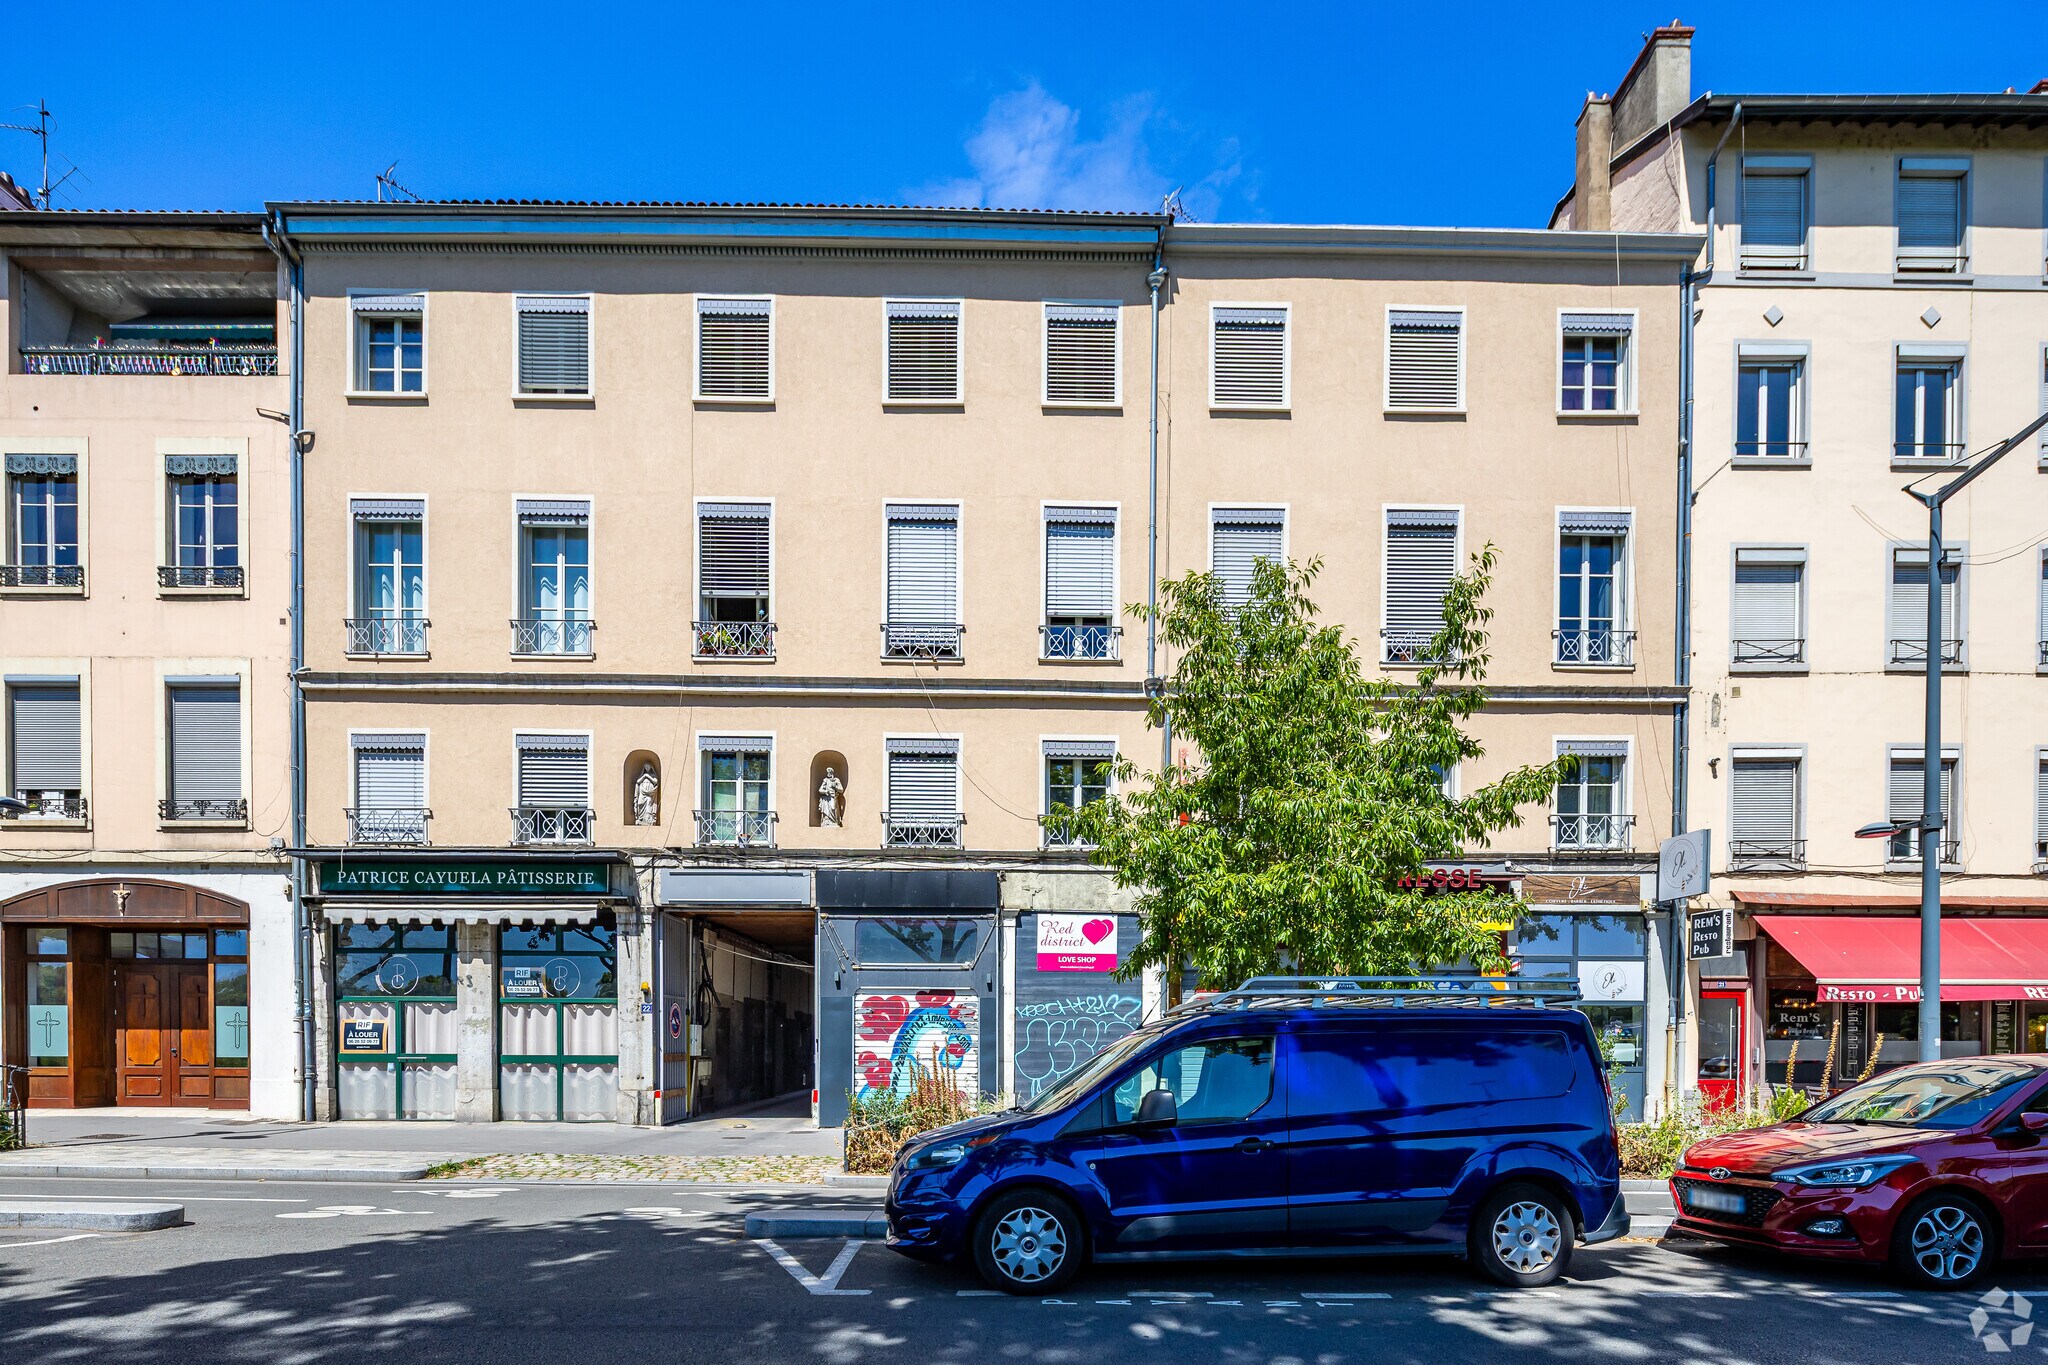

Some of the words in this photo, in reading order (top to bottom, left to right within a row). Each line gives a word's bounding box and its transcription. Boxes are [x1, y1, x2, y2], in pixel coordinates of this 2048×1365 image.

[337, 871, 409, 884] PATRICE
[414, 871, 492, 884] CAYUELA
[497, 869, 594, 885] PÂTISSERIE
[1041, 920, 1074, 934] Red
[1694, 915, 1721, 929] REM'S
[1040, 934, 1086, 946] district
[1693, 944, 1710, 955] Pub
[348, 1029, 354, 1038] À
